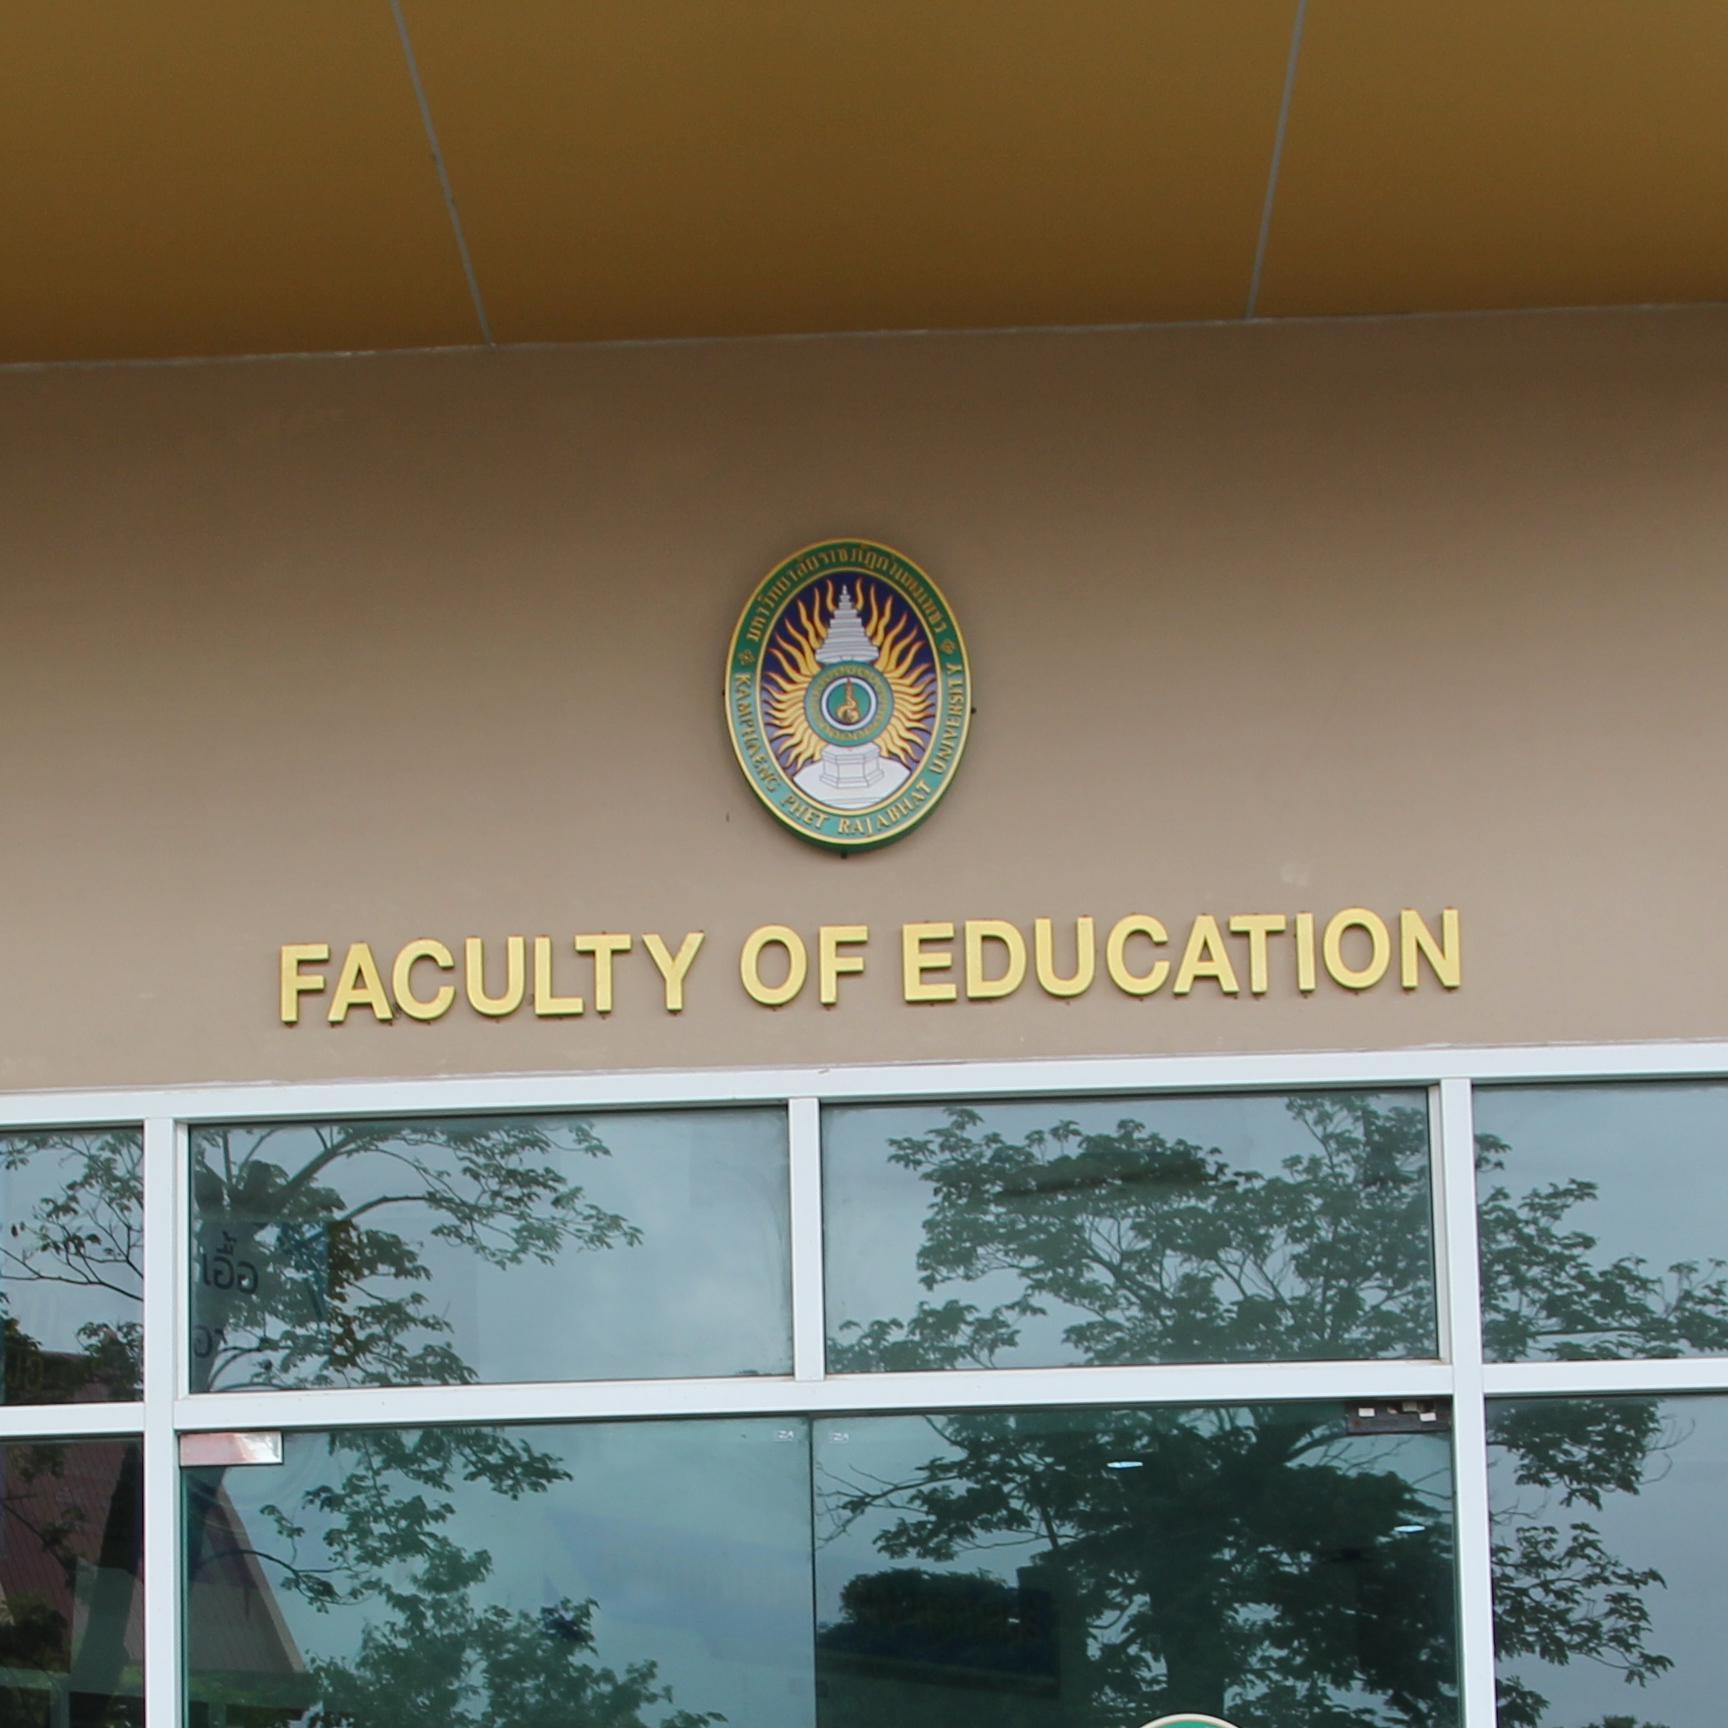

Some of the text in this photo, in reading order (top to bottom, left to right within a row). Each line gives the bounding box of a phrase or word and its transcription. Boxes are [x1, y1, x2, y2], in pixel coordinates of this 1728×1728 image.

[734, 672, 780, 793] KAMPHAENG
[781, 794, 832, 829] PHET
[838, 780, 932, 836] RAJABHAT
[930, 662, 964, 775] UNIVERSITY
[280, 907, 1461, 1024] FACULTY OF EDUCATION
